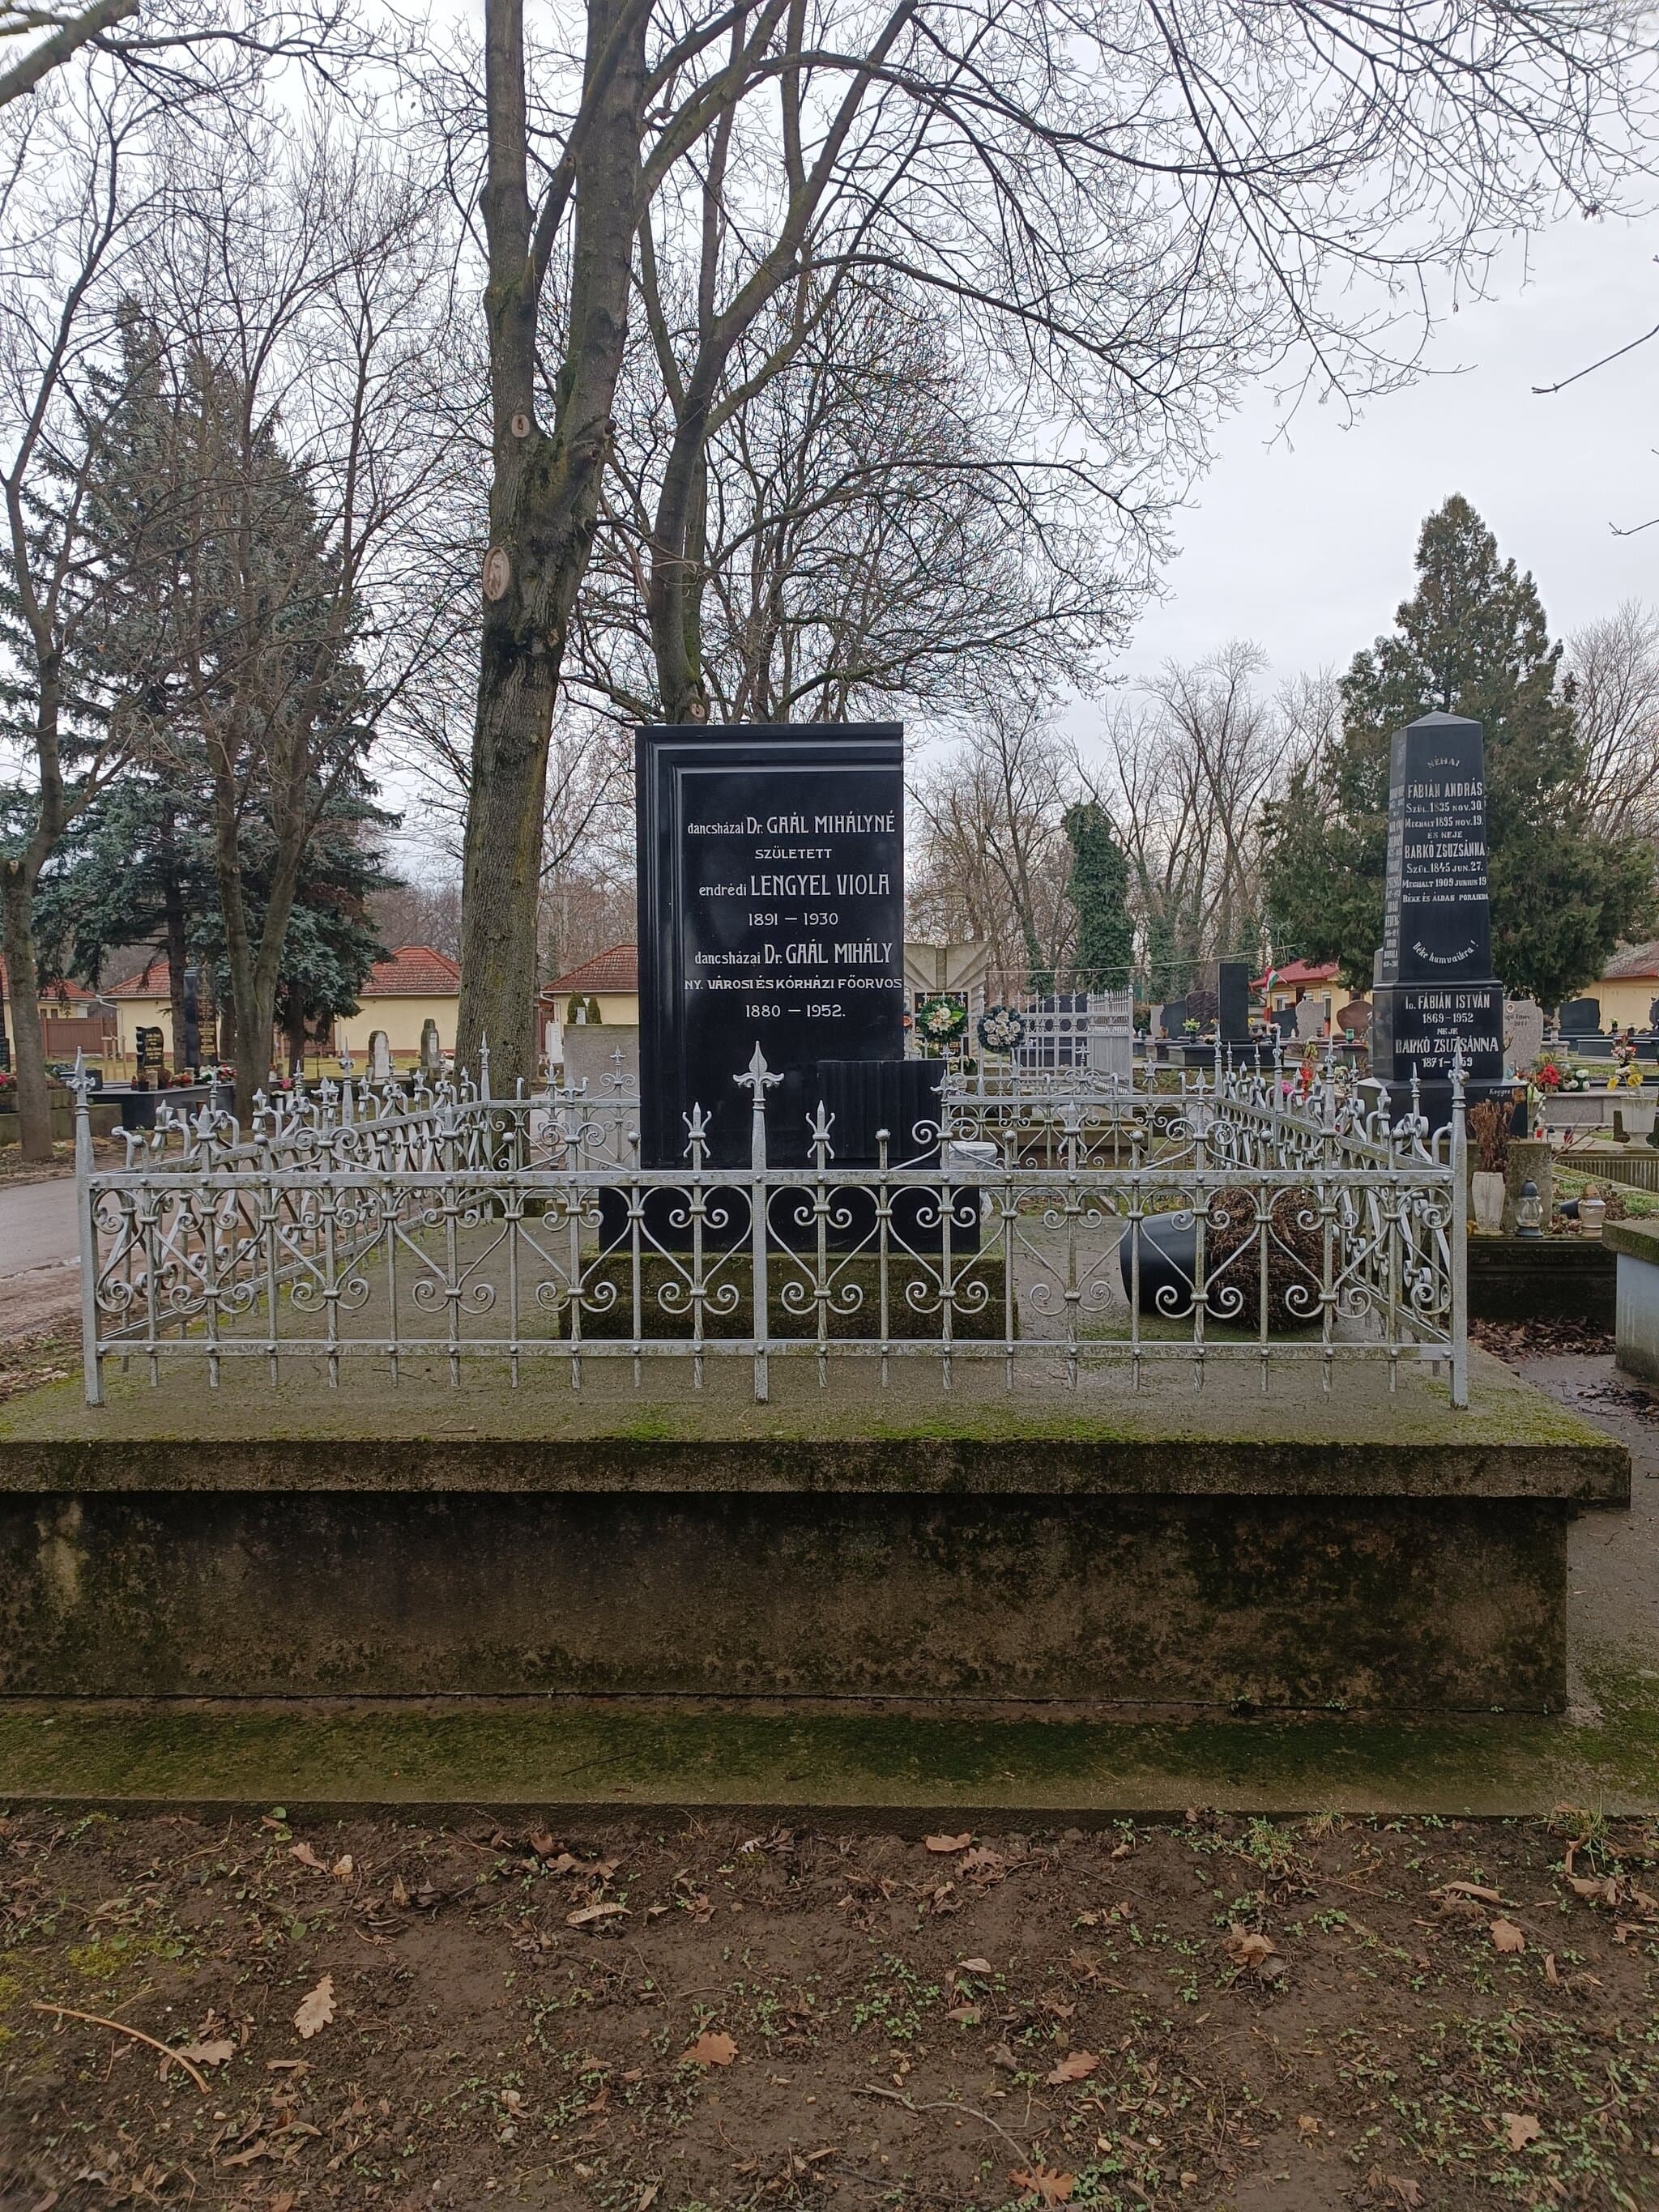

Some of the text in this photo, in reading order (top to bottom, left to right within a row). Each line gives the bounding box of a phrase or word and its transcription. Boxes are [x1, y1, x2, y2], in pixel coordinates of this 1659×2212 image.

[1408, 778, 1482, 799] FÁBIÁN ANDRÁS
[688, 810, 895, 834] dancsházai Dr. GAÁL MIHÁLYNÉ
[1435, 816, 1453, 827] 1895
[1441, 831, 1463, 839] NEJE
[755, 845, 832, 859] SZÜLETETT
[1405, 839, 1485, 859] BARKÓ ZSUZSÁNNA
[1431, 862, 1450, 873] 1845
[699, 873, 890, 896] endrédi LENGYEL VIOLA
[1435, 878, 1454, 887] 1909
[748, 913, 778, 926] 1891
[804, 912, 838, 926] 1930
[695, 938, 893, 965] dancsházai Dr. GAÁL MIHÁLY
[684, 974, 902, 989] NY. VÁROSI ÉS KÓRHÁZI FŐORVOS
[1418, 992, 1451, 1009] FÁBIÁN
[1456, 991, 1490, 1008] ISTVÁN
[745, 1004, 781, 1017] 1880
[806, 1004, 846, 1017] 1952.
[1437, 1027, 1458, 1035] NEJE
